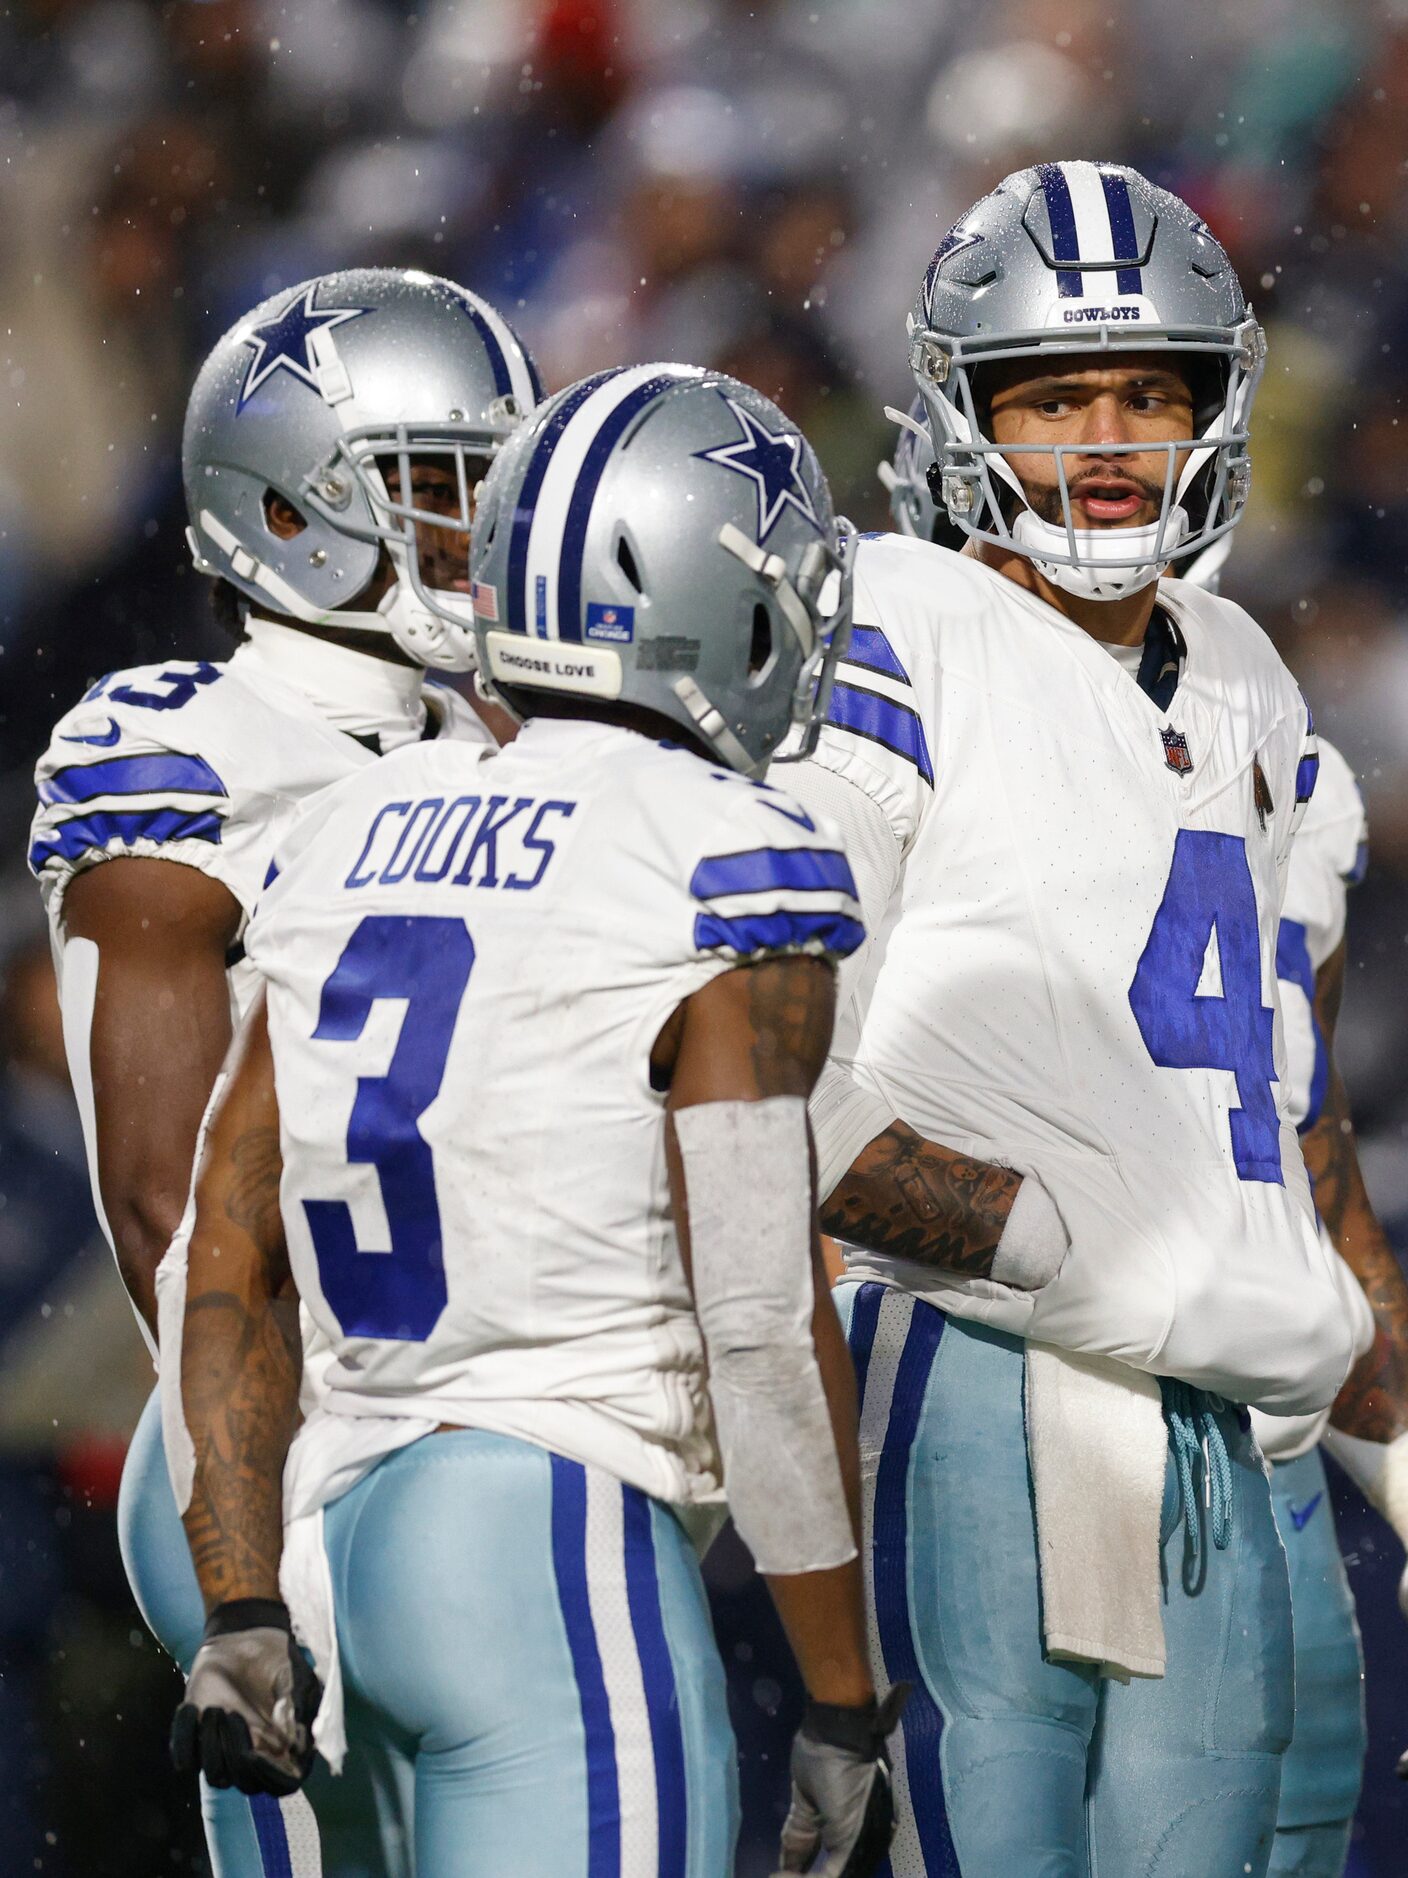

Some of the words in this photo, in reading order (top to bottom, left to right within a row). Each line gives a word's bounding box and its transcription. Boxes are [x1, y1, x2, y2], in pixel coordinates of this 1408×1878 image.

[1063, 306, 1141, 324] COWBOYS
[500, 651, 551, 673] CHOOSE
[555, 663, 595, 677] LOVE
[344, 795, 577, 891] COOKS
[1128, 828, 1287, 1188] 4
[300, 915, 476, 1342] 3
